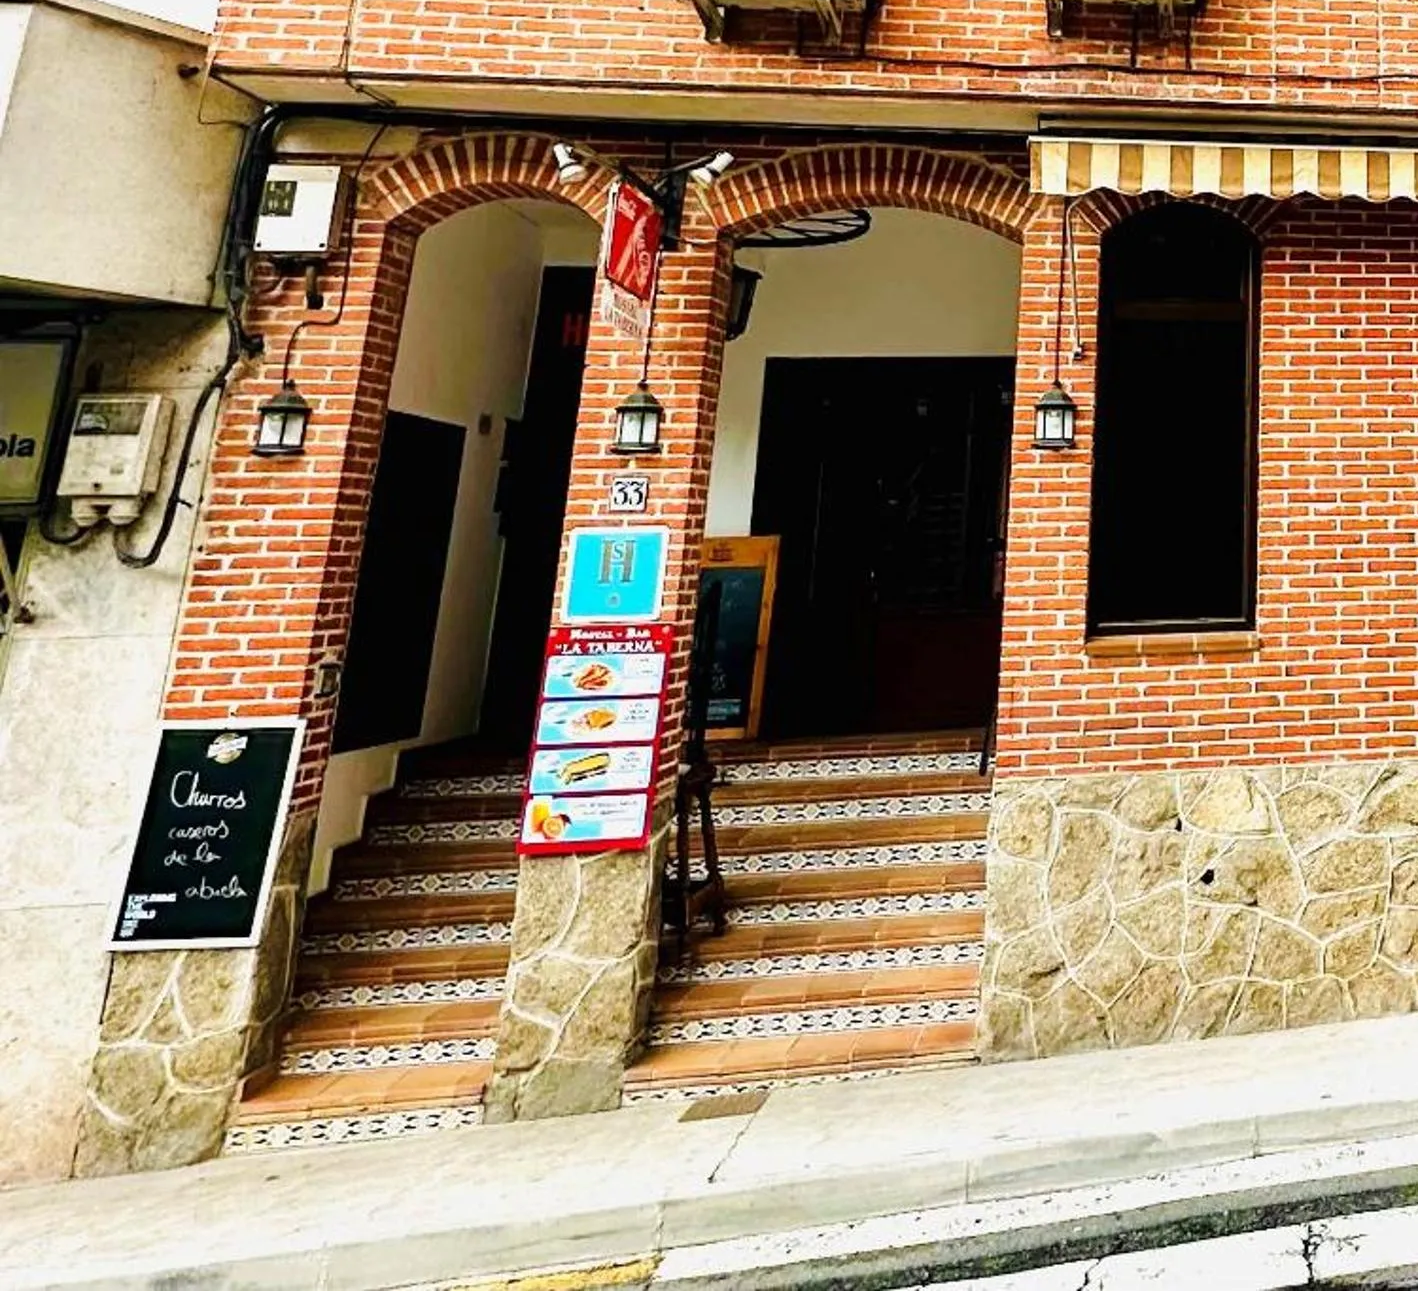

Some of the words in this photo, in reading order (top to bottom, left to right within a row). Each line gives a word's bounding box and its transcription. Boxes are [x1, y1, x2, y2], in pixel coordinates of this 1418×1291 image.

[614, 481, 645, 505] 33
[168, 820, 229, 839] caseros
[164, 850, 187, 866] de
[192, 841, 222, 863] la
